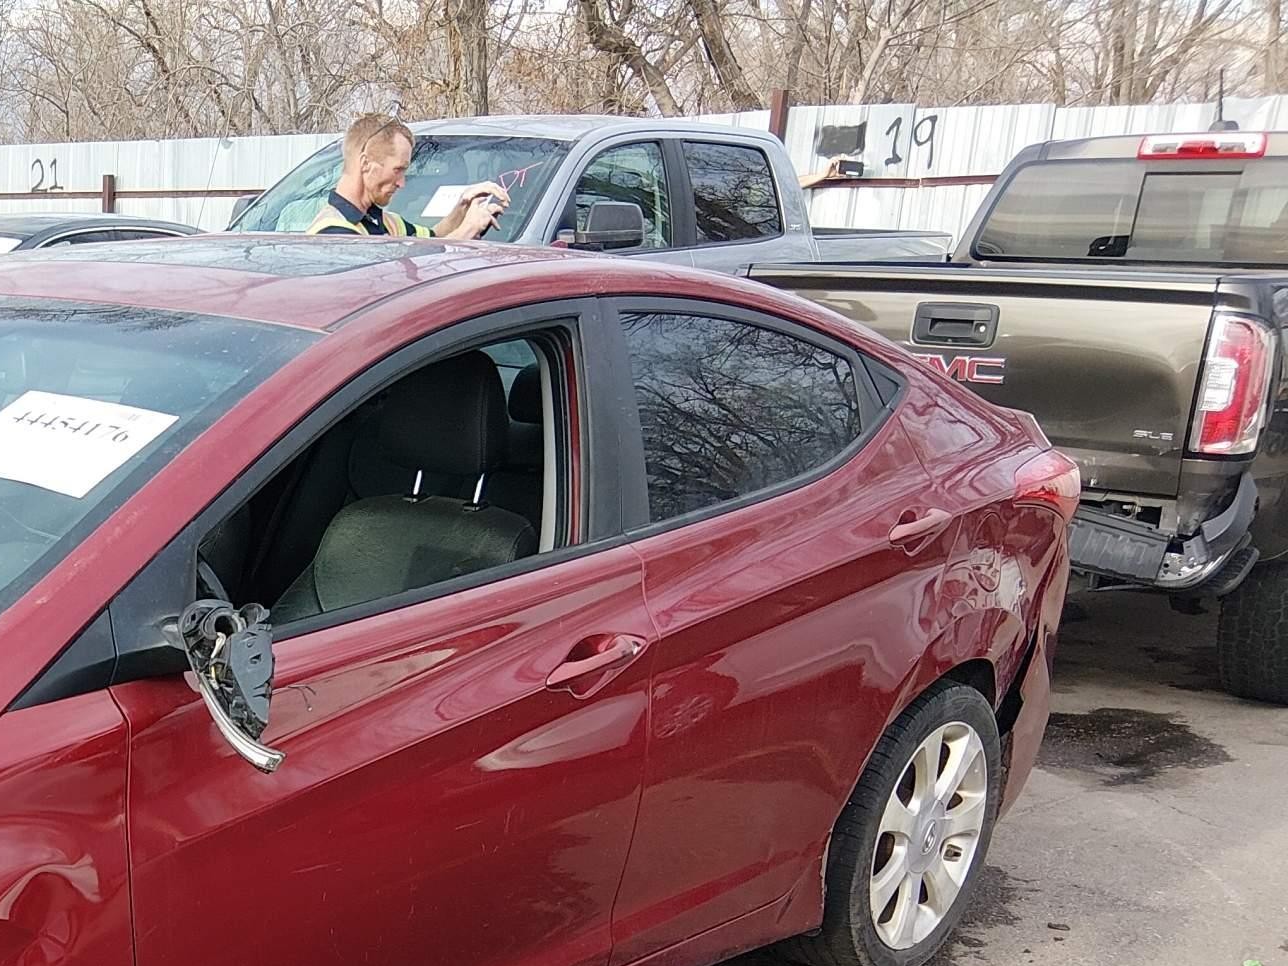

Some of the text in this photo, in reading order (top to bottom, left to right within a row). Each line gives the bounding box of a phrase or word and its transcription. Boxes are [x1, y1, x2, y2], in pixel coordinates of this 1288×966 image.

[884, 115, 938, 170] 19
[31, 158, 64, 192] 21
[911, 352, 1006, 385] MC
